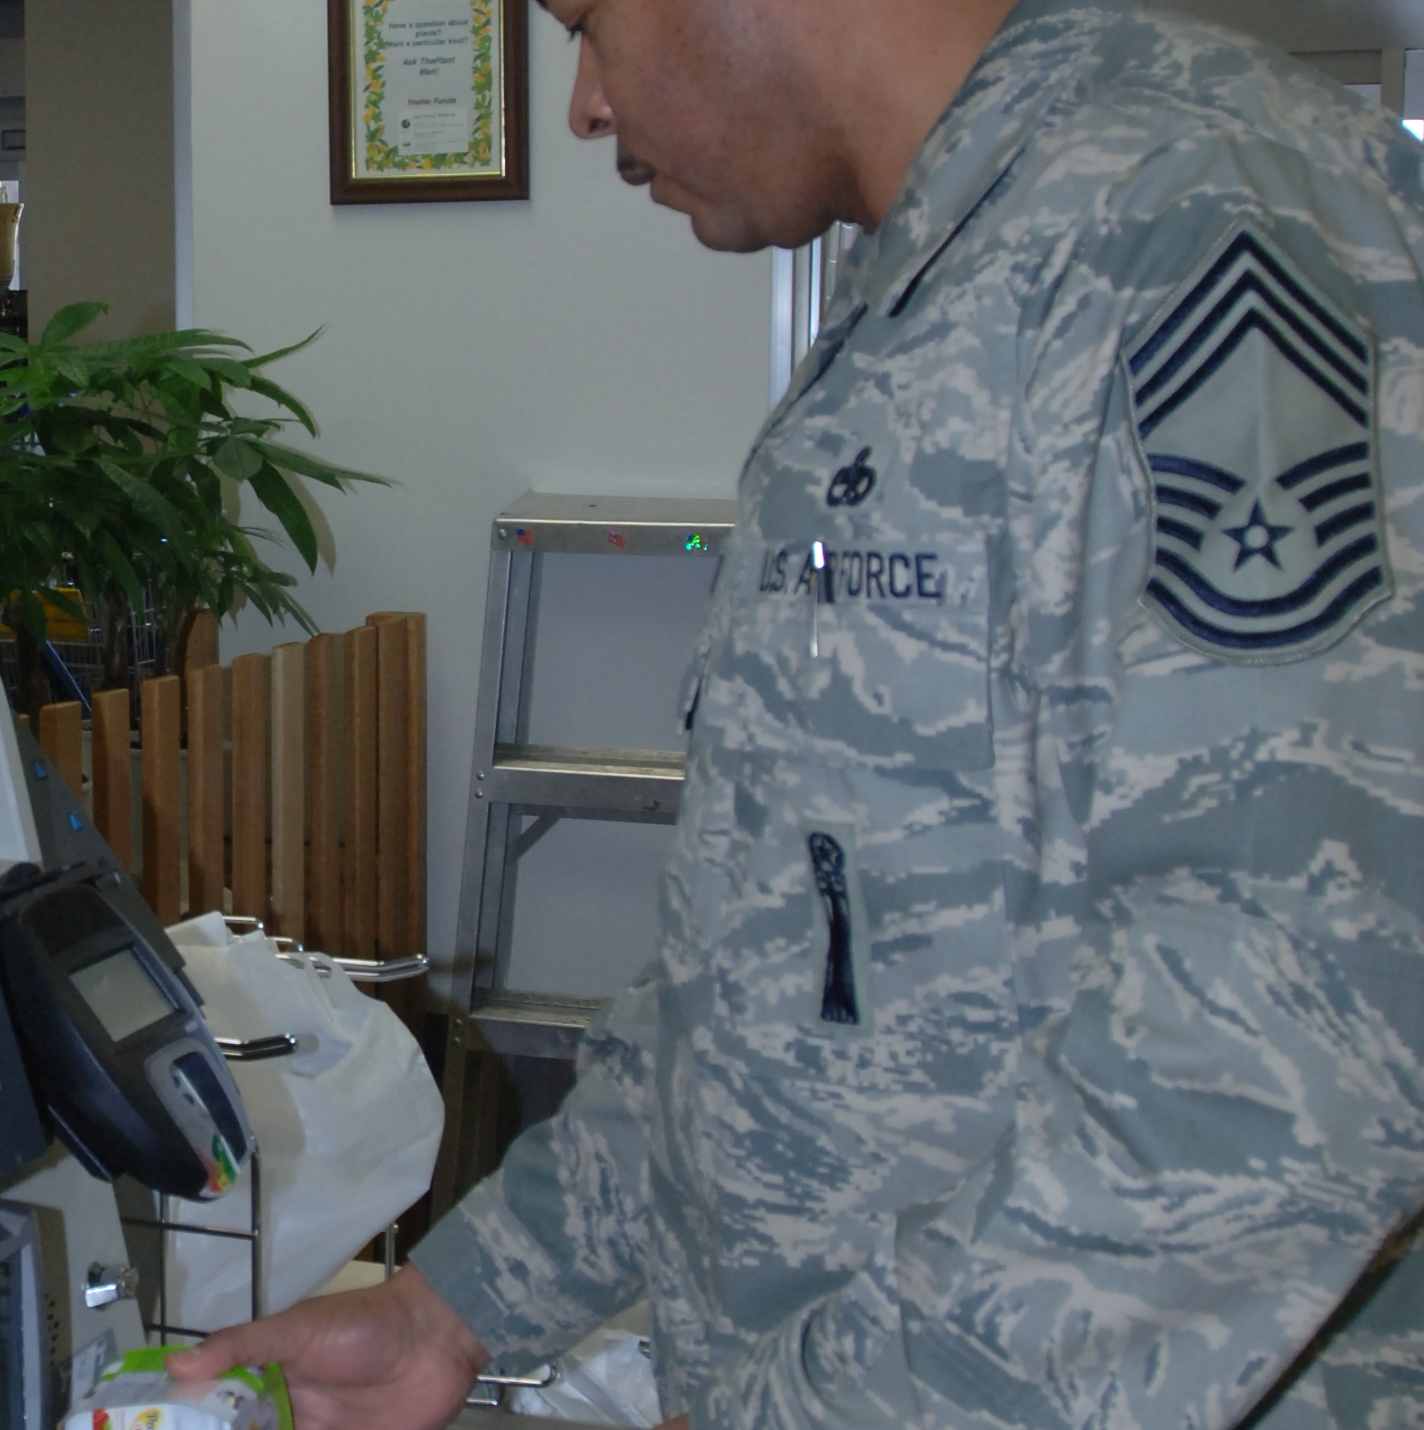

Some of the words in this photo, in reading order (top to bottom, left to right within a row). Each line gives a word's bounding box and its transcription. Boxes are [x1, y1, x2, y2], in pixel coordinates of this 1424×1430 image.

[415, 21, 446, 29] question
[412, 39, 446, 48] particular
[840, 550, 943, 598] FORCE
